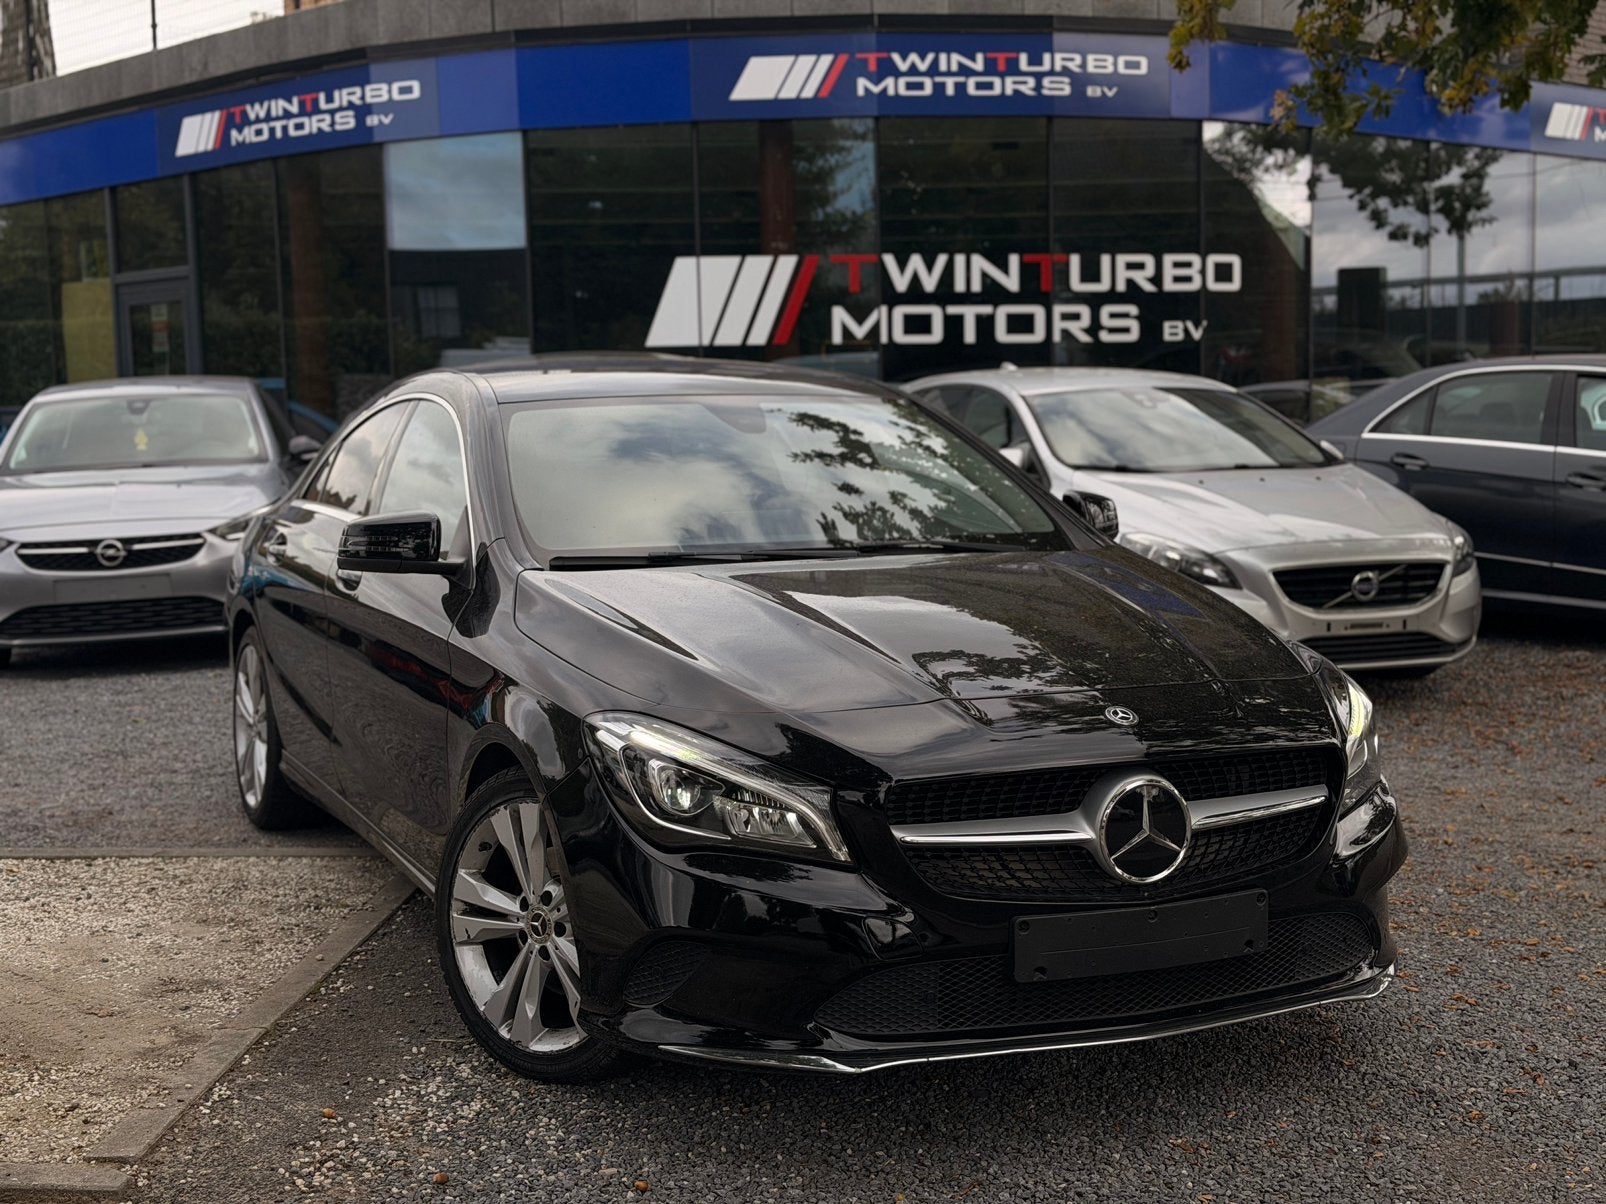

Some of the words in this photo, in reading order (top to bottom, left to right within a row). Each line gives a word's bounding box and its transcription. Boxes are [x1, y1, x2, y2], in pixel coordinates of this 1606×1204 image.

[855, 52, 1149, 76] TWINTURBO
[228, 79, 421, 125] TWINTURBO
[856, 76, 1072, 97] MOTORS
[1085, 85, 1118, 98] BV
[230, 110, 356, 147] MOTORS
[365, 112, 394, 127] BV
[830, 252, 1243, 294] TWINTURBO
[830, 303, 1141, 345] MOTORS
[1162, 320, 1208, 342] BV
